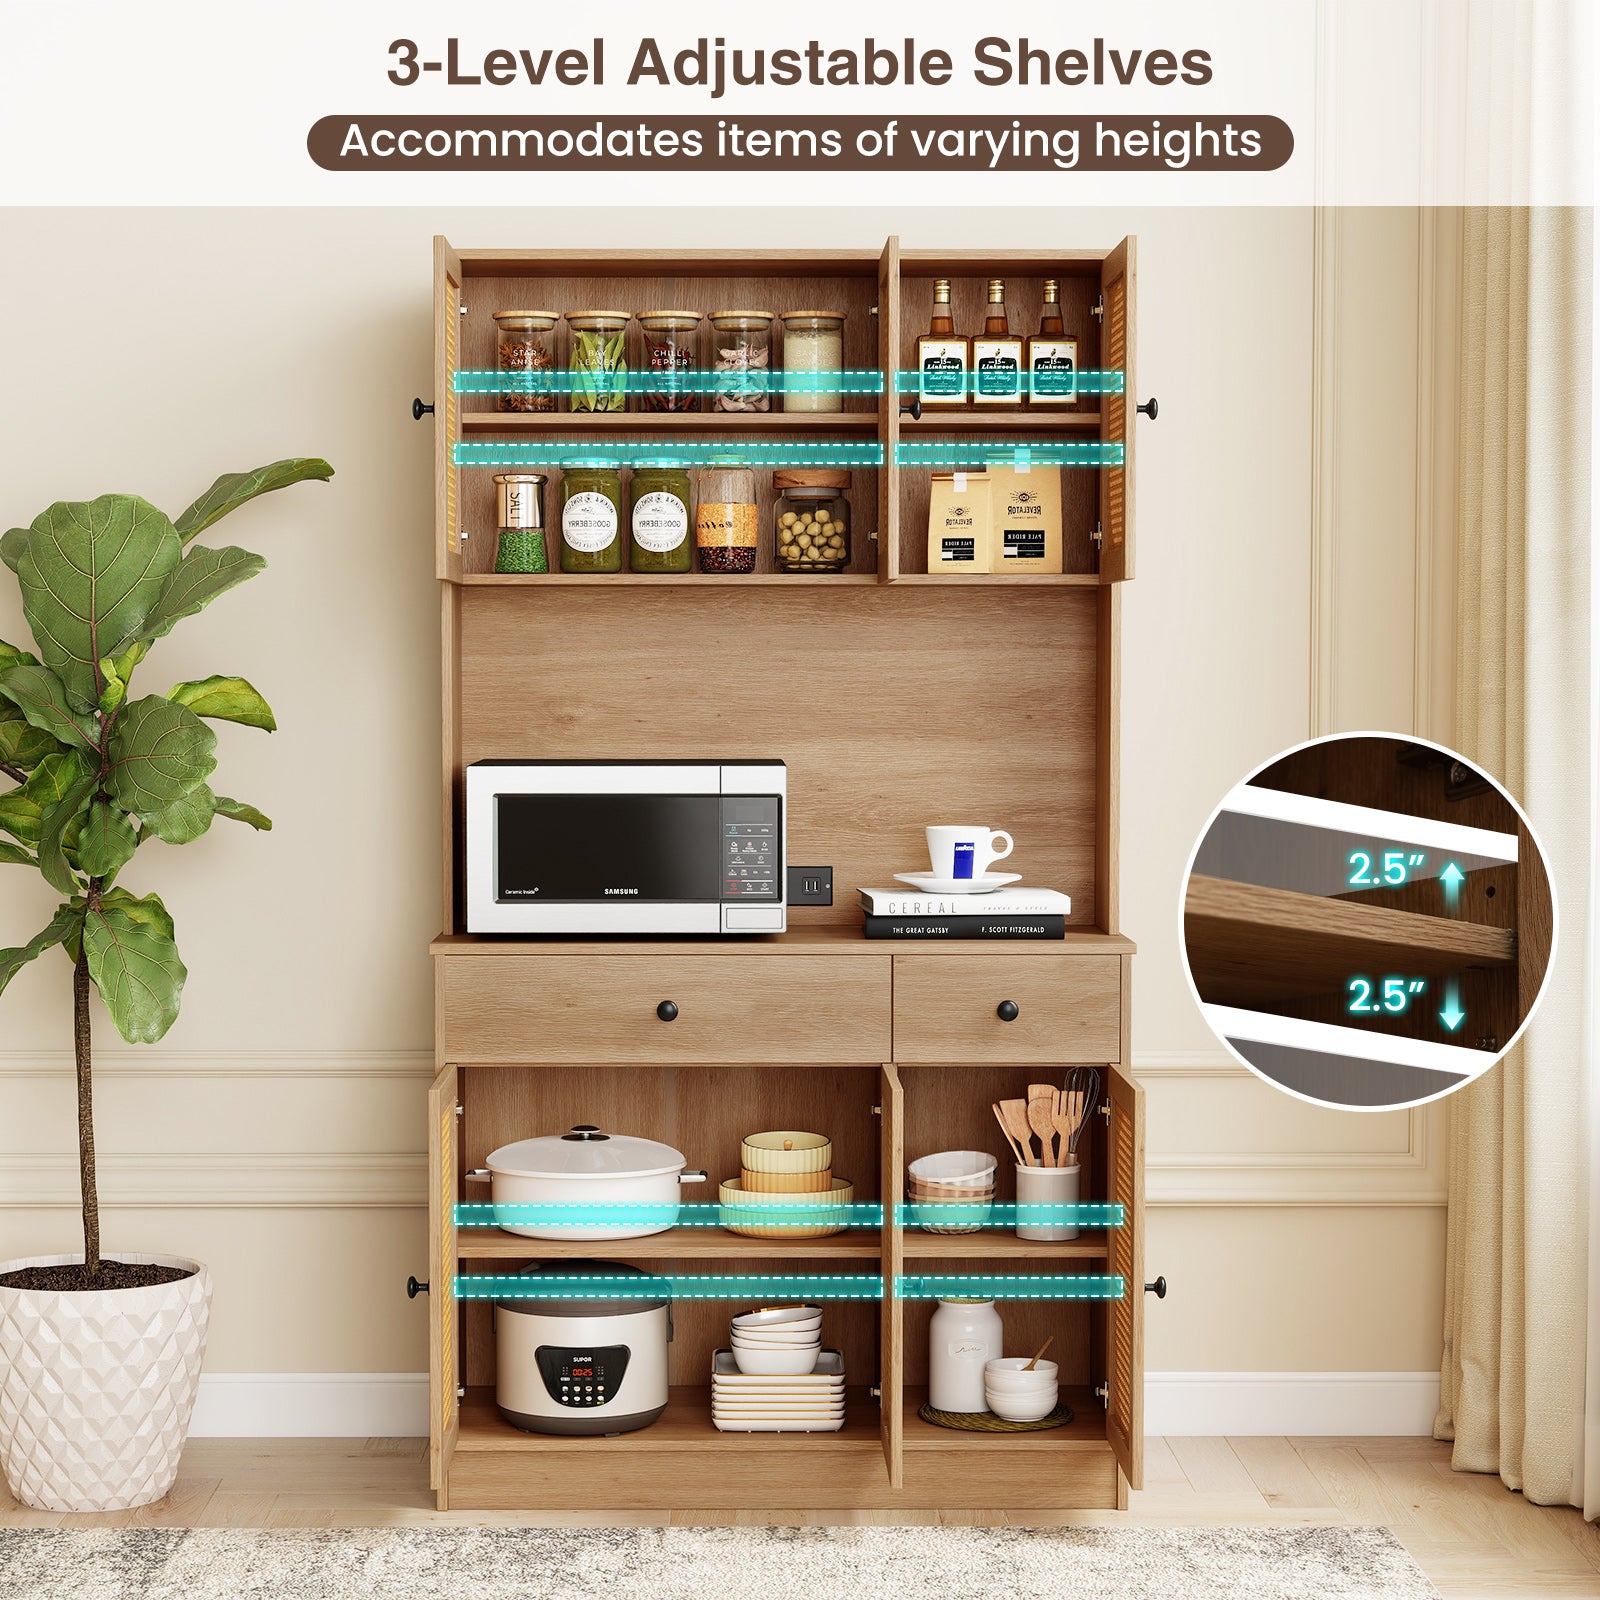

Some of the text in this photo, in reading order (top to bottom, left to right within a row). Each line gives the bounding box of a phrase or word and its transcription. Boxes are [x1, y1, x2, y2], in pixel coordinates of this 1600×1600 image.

[513, 349, 537, 357] STAR
[588, 349, 607, 357] BAY
[653, 349, 686, 357] CHILLI
[511, 358, 540, 366] ANISE
[651, 358, 688, 366] PEPPER
[889, 902, 957, 914] CEREAL
[1009, 926, 1045, 934] FITZGERALD
